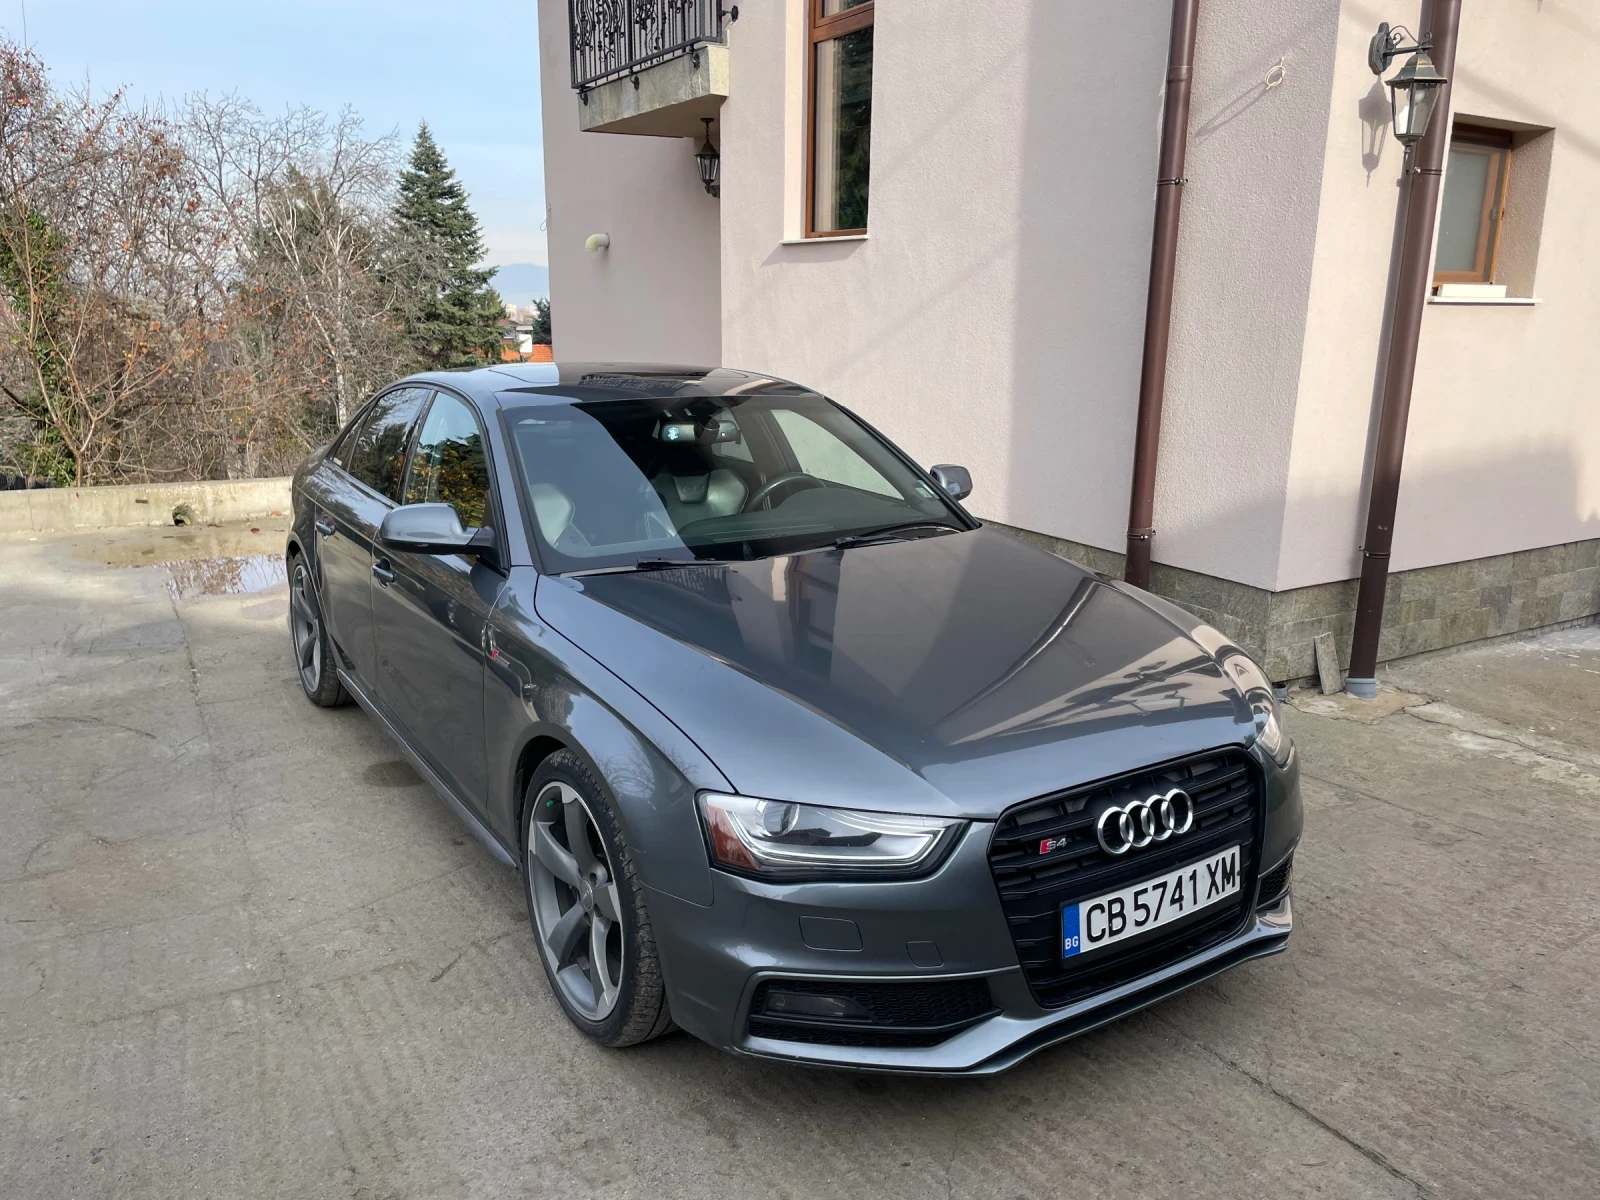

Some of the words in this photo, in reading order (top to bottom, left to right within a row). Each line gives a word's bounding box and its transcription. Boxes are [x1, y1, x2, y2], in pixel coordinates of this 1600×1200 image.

[1086, 897, 1127, 943] CB
[1133, 869, 1198, 927] 5741
[1206, 852, 1236, 900] XM
[1065, 936, 1079, 950] BG
